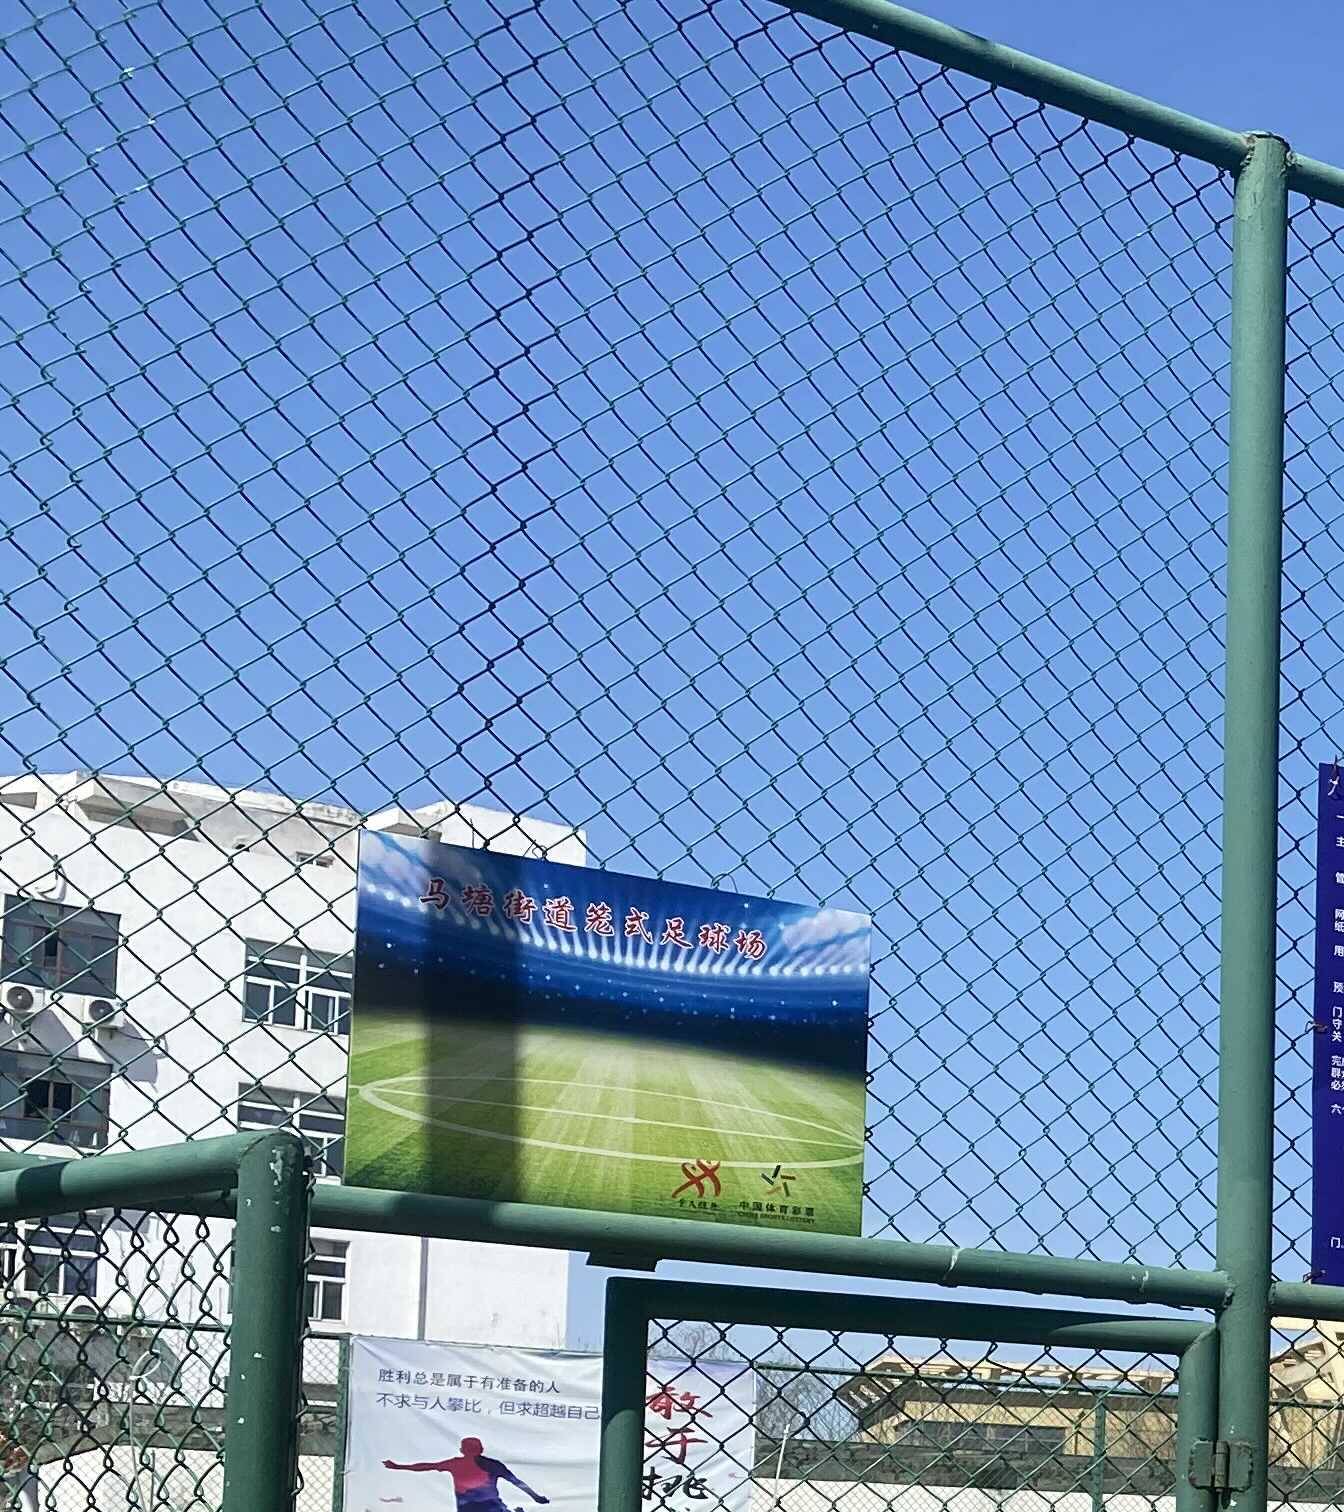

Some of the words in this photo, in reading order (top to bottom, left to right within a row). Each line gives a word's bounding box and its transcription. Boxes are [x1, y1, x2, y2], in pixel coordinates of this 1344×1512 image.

[419, 878, 768, 961] 马塘街道笼式足球场
[378, 1368, 560, 1394] 胜利总是属于有准备的人
[376, 1392, 601, 1421] 不求与人攀比，但求超越自己
